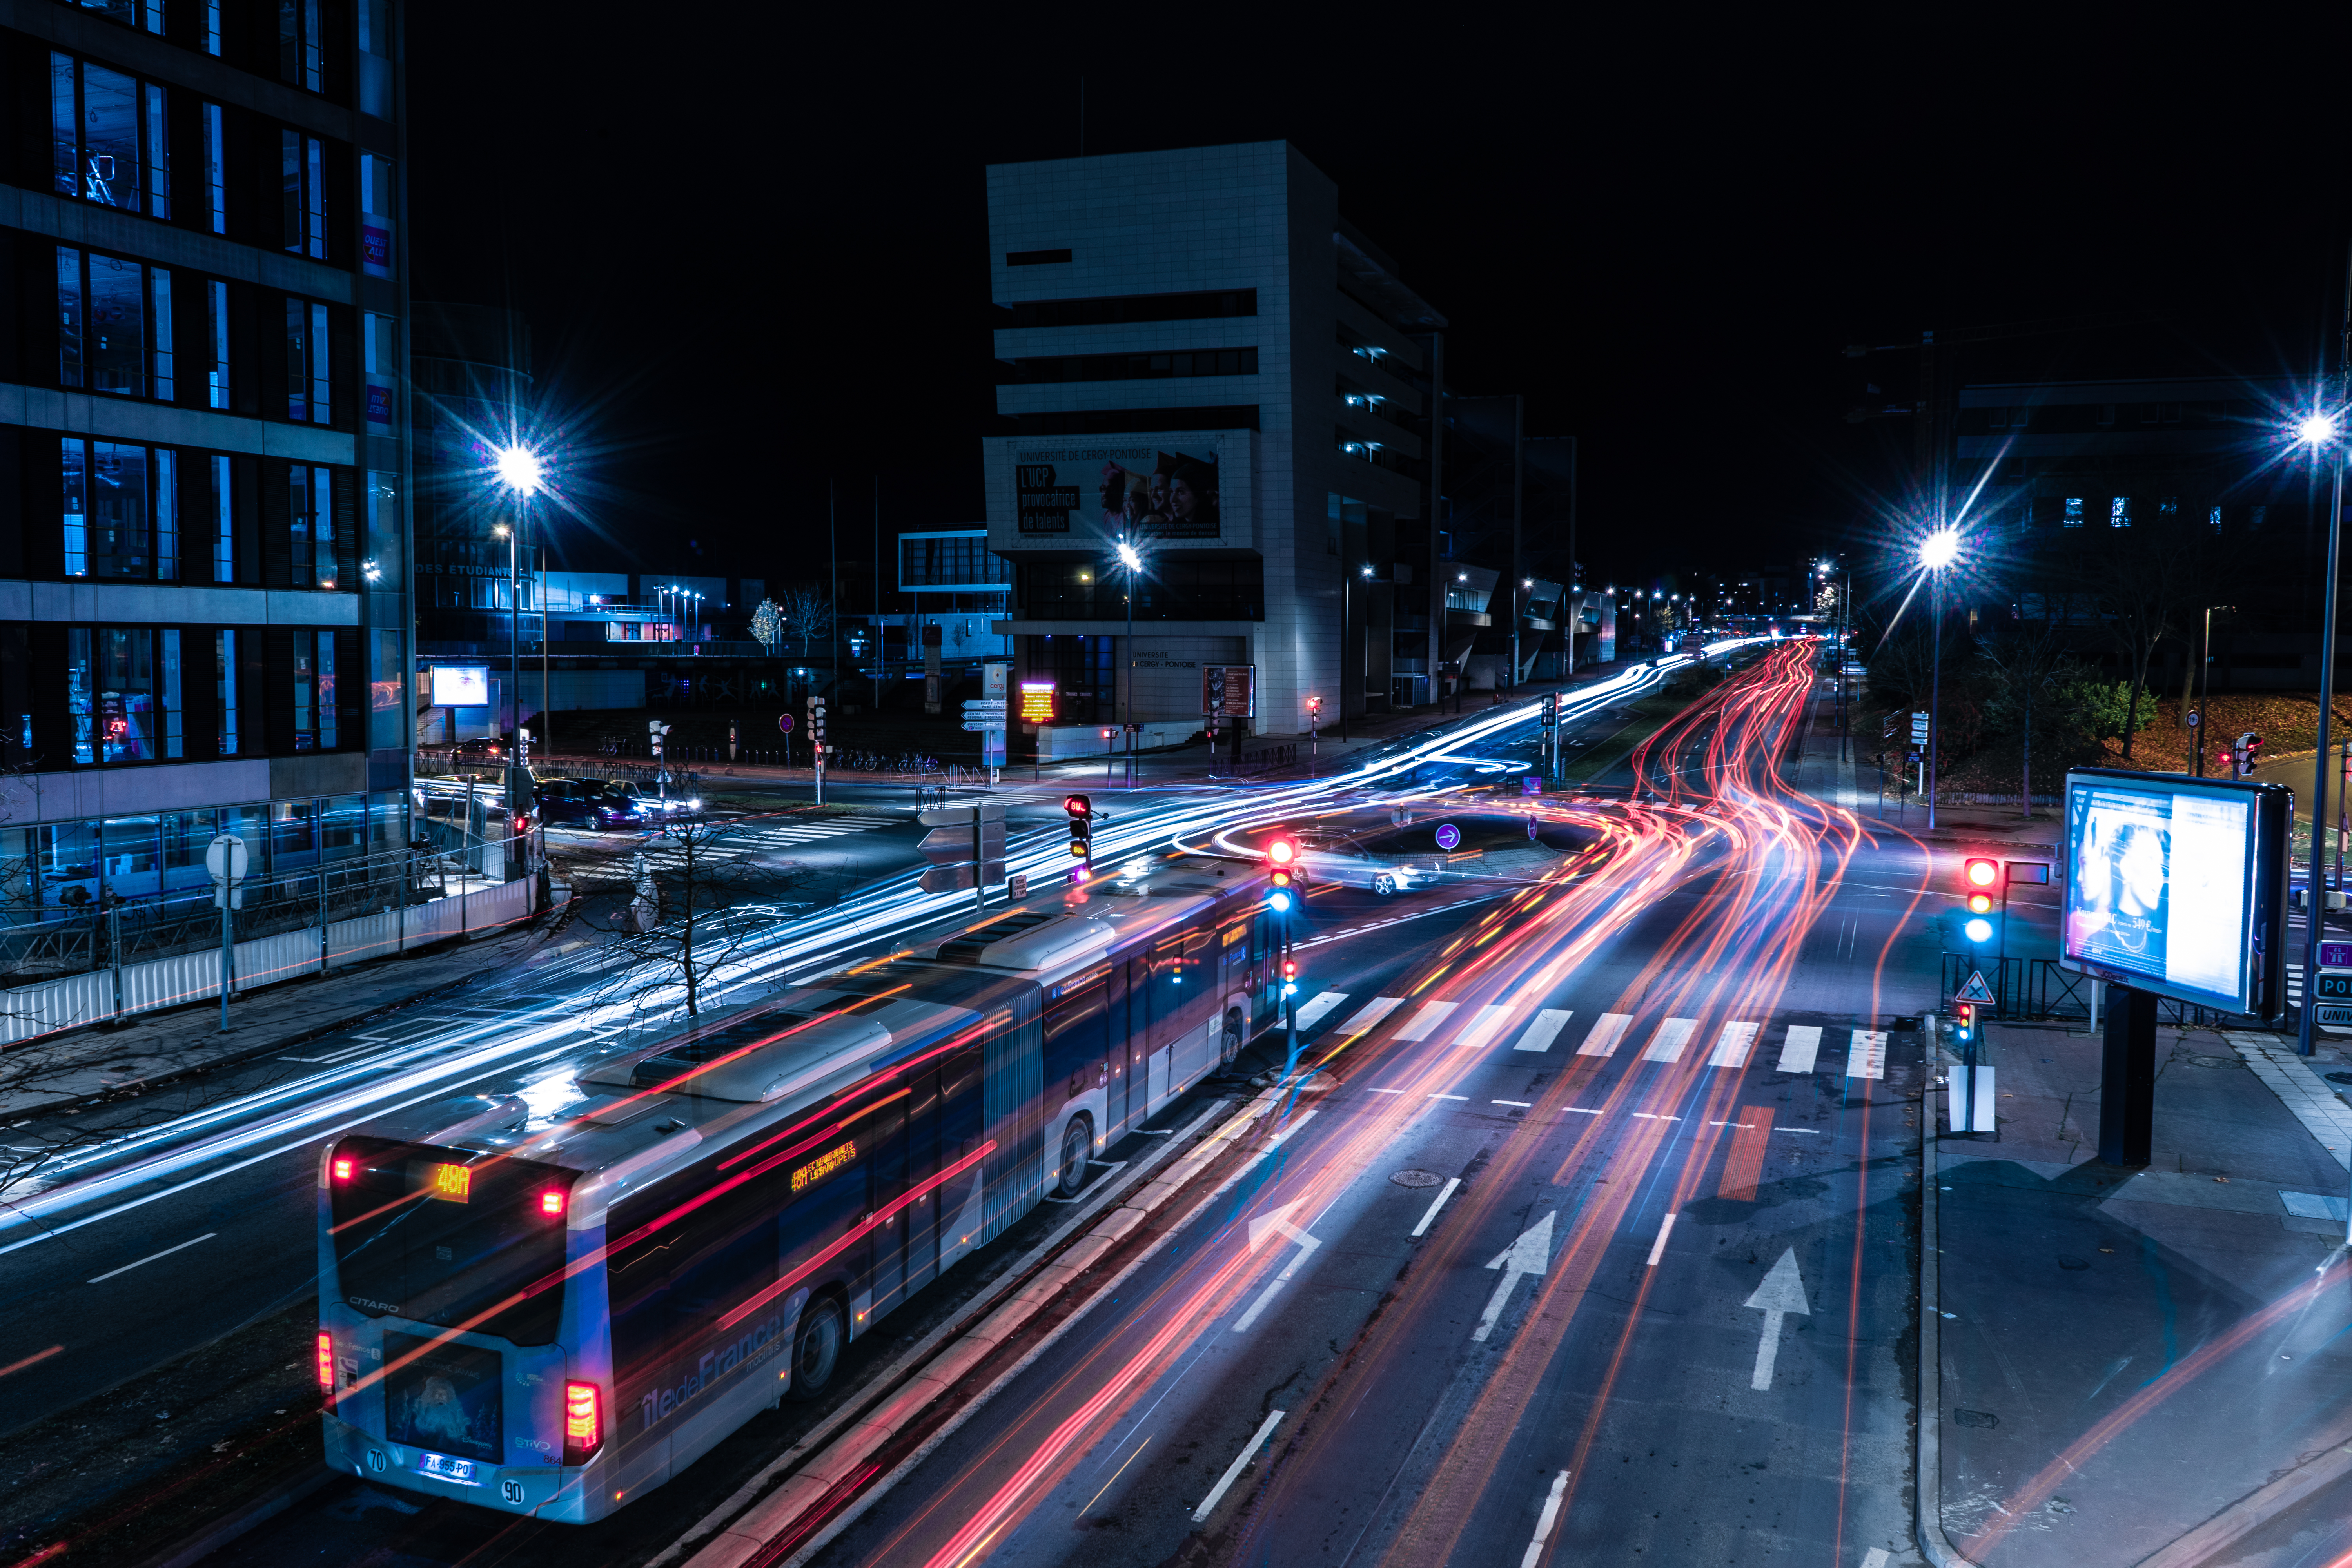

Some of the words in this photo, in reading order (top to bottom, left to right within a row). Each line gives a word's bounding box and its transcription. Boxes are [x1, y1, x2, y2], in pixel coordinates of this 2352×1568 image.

[364, 234, 388, 247] OUEST
[368, 246, 384, 257] ALU
[1020, 449, 1066, 462] UNIVERSITÉ
[1069, 450, 1079, 461] DE
[1081, 449, 1151, 461] CERGY-PONTOISE
[1021, 467, 1049, 488] L'UCP
[1022, 489, 1075, 510] provocatrice
[1024, 512, 1033, 529] de
[1036, 512, 1065, 529] talents
[414, 564, 443, 574] DES
[449, 562, 512, 577] ÉTUDIANTS
[2101, 970, 2129, 983] JCDecaux
[2325, 980, 2352, 993] PO
[437, 1164, 469, 1195] 48A
[349, 1296, 399, 1313] CITARO
[423, 1360, 452, 1372] COMME
[454, 1366, 480, 1379] JAMAIS
[370, 1451, 383, 1471] 70
[543, 1455, 562, 1465] 864
[505, 1481, 521, 1503] 90
